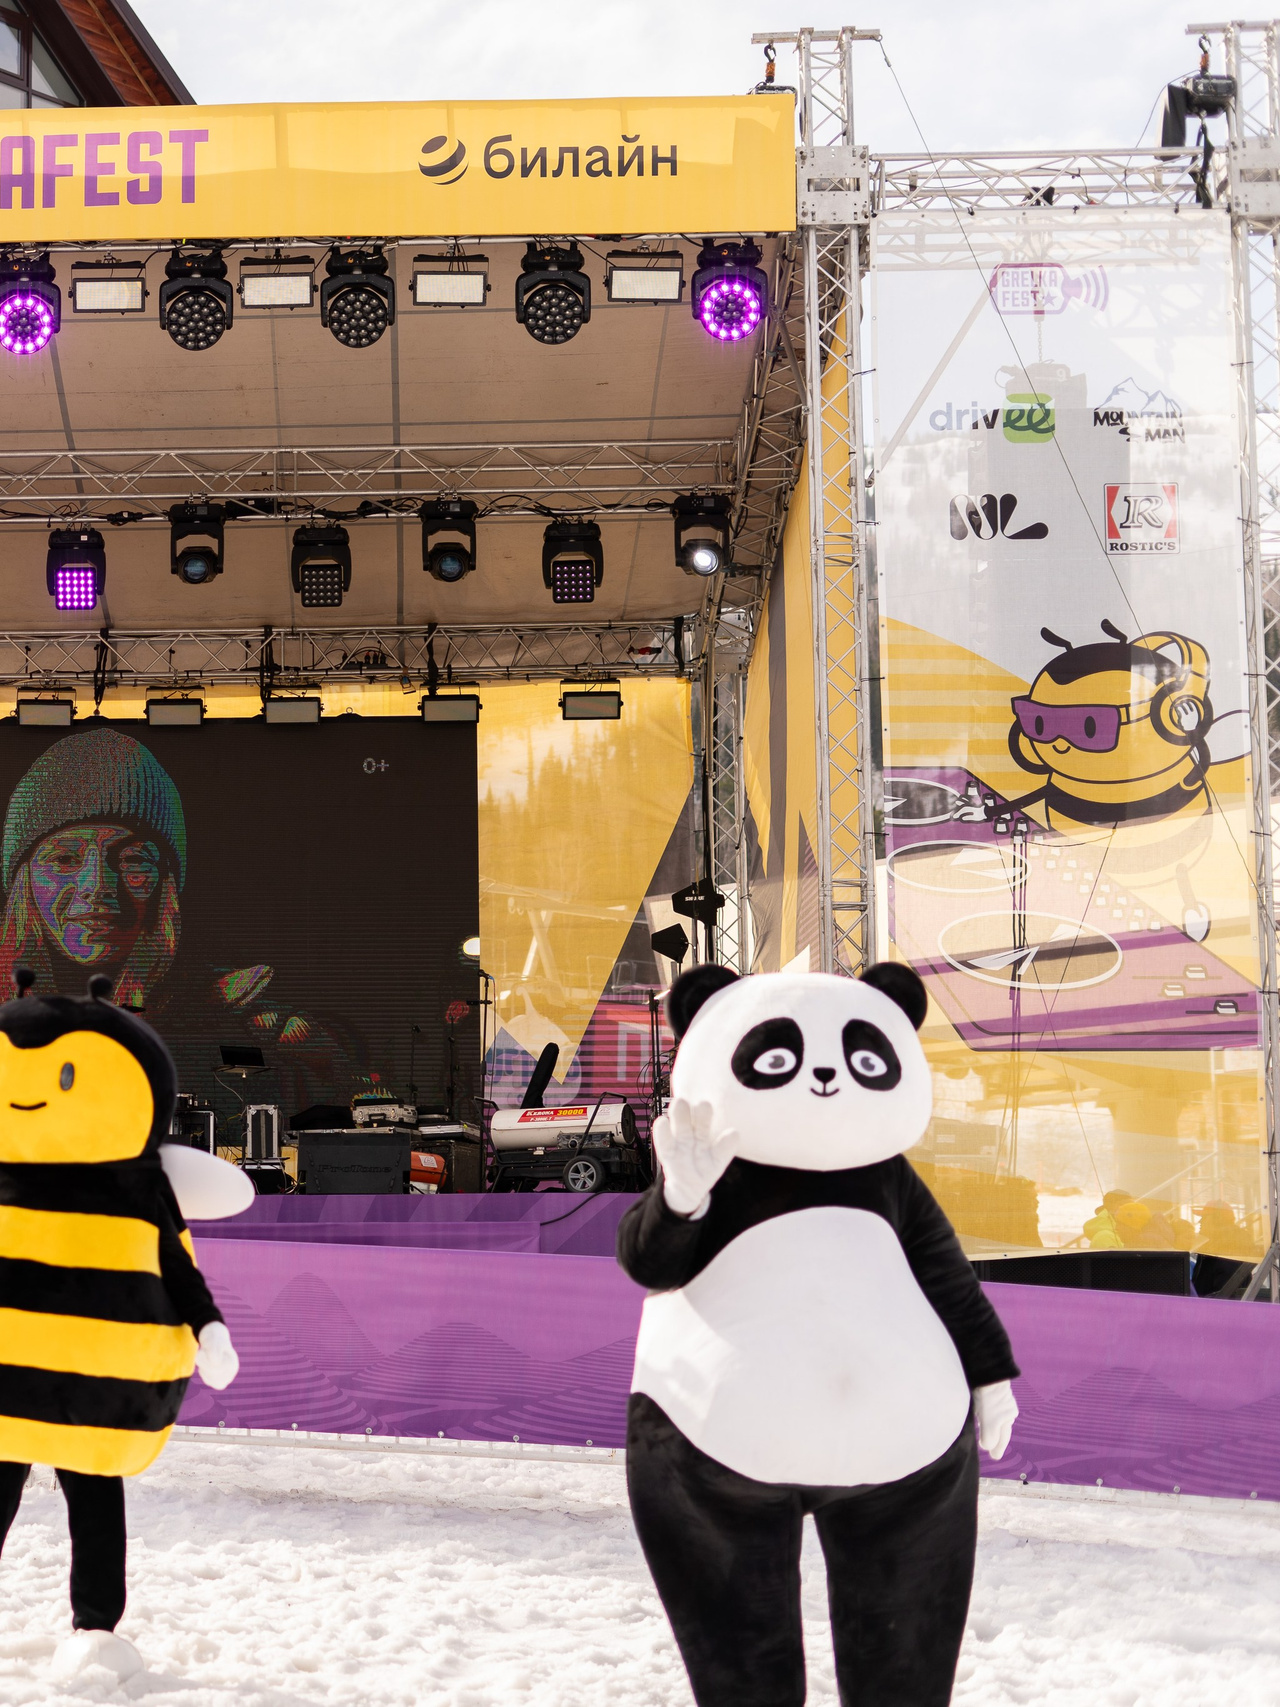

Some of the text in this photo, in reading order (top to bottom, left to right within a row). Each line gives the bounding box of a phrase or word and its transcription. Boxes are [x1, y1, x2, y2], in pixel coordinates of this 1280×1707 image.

[483, 134, 678, 179] билайн
[1001, 270, 1058, 288] GRELKA
[1001, 290, 1040, 307] FEST
[929, 401, 1056, 434] drivee
[1145, 428, 1185, 443] MAN
[1109, 541, 1177, 552] ROSTIC'S
[557, 1108, 584, 1116] 30000
[316, 1164, 393, 1173] ProTone
